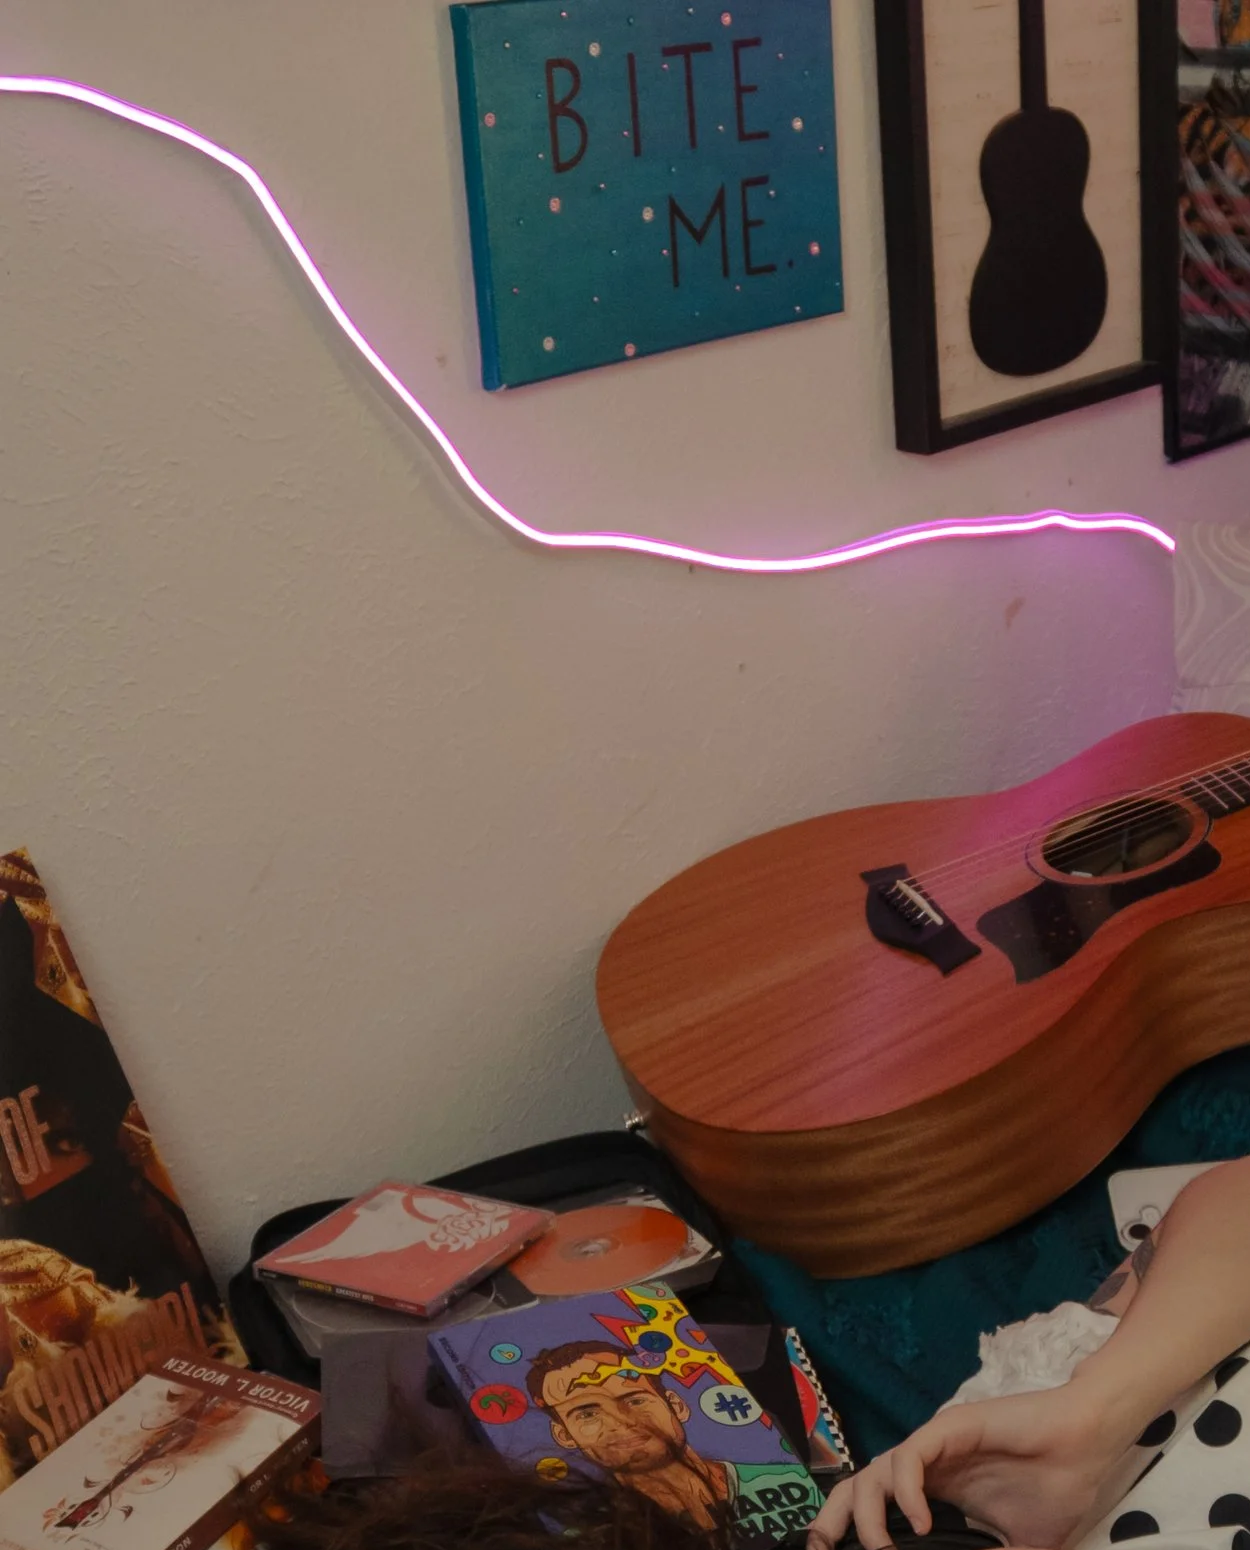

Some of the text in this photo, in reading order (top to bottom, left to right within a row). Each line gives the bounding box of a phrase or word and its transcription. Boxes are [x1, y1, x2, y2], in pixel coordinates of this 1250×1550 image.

[545, 37, 770, 174] BITE
[668, 175, 796, 289] ME.
[162, 1353, 229, 1387] WOOTEN
[237, 1377, 249, 1391] L.
[248, 1381, 308, 1412] VICTOR
